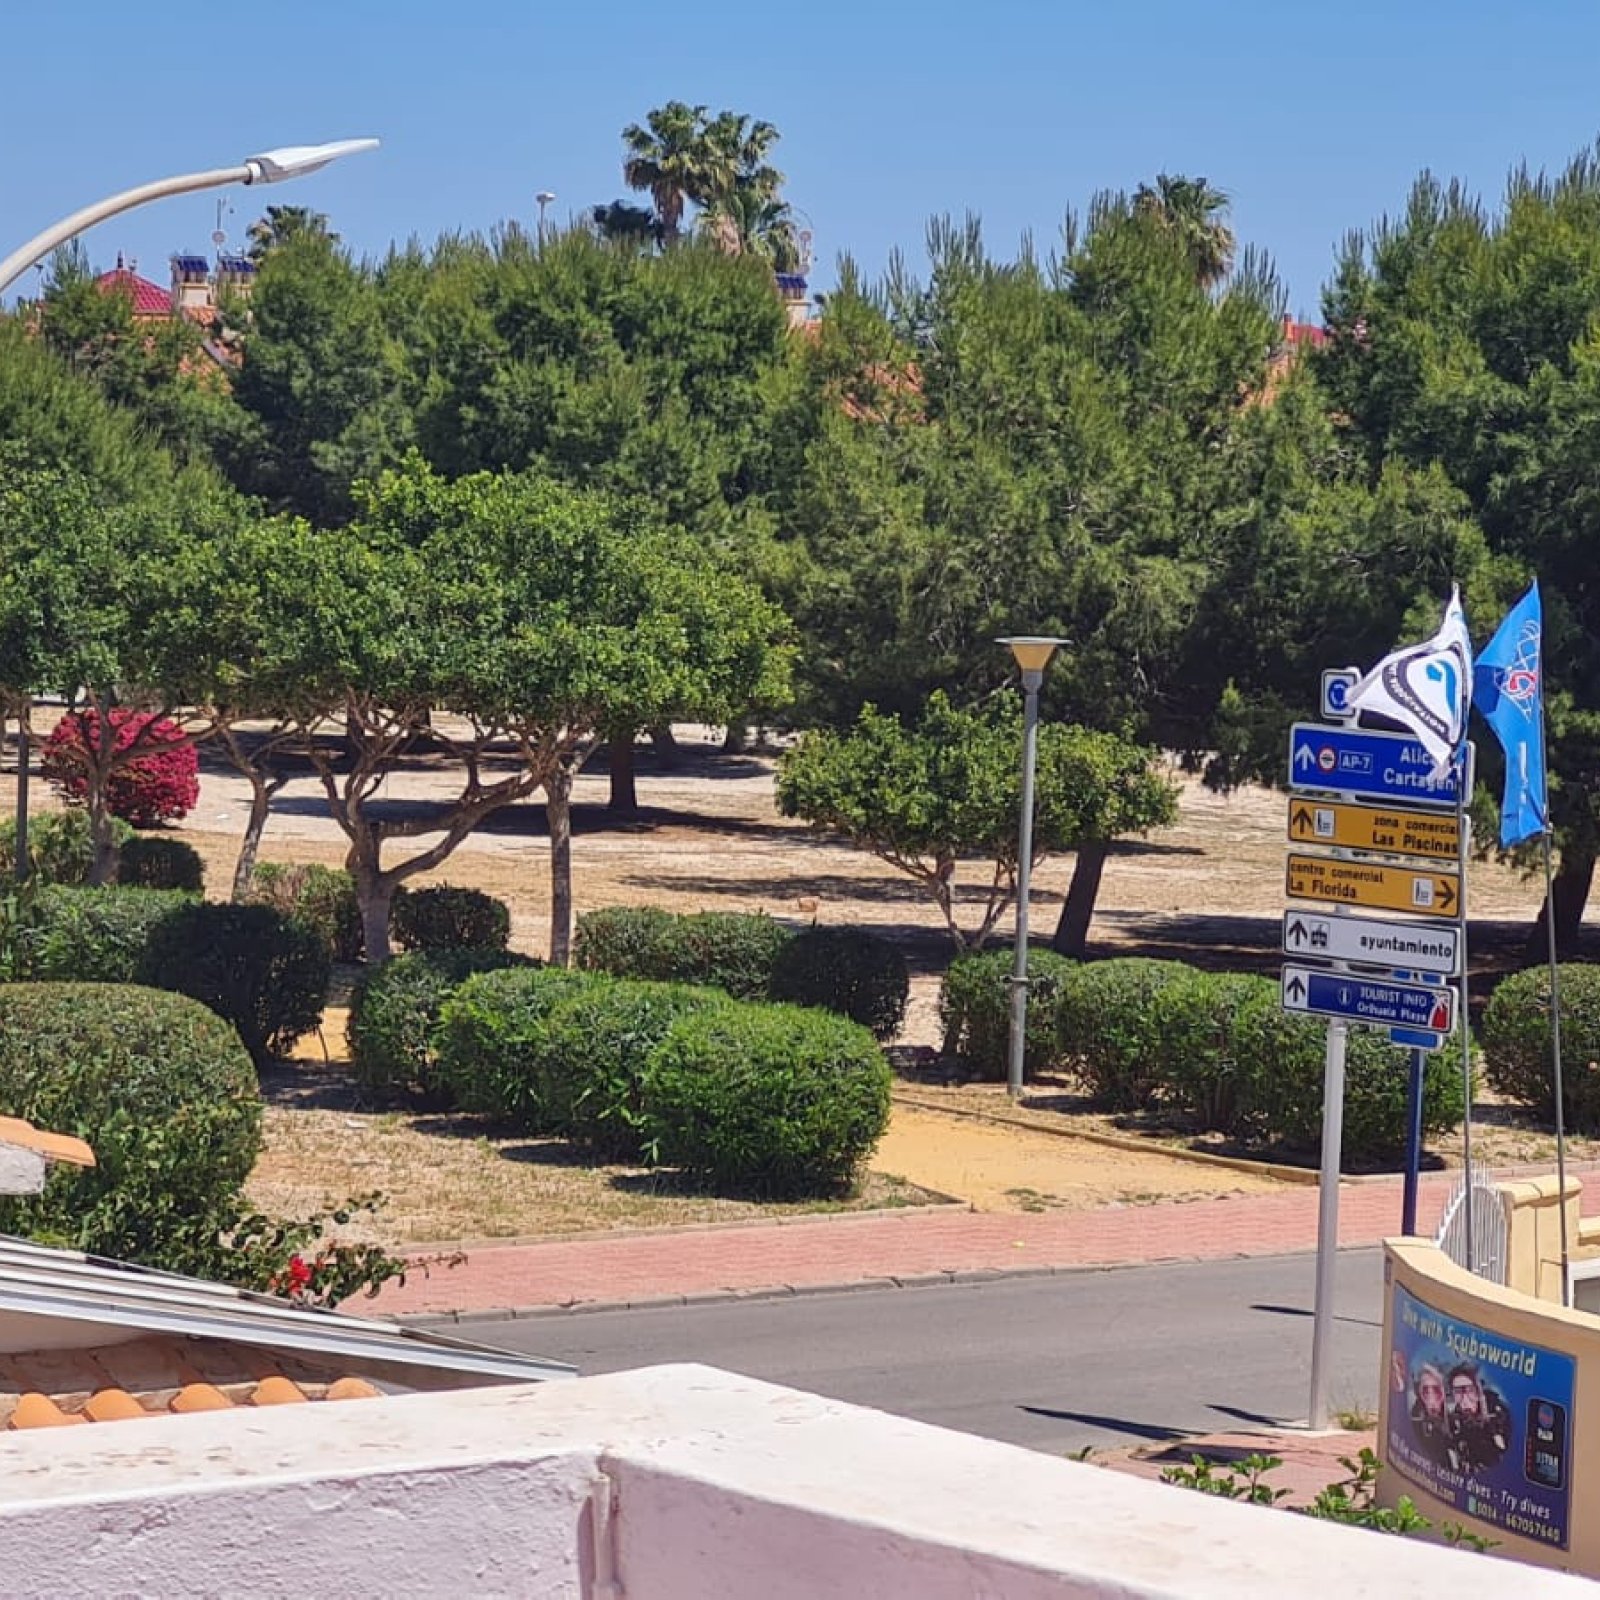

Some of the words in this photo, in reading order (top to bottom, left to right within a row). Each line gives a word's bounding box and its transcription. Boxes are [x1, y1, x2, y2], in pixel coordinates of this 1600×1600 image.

[1341, 754, 1371, 769] AP-7
[1374, 815, 1399, 828] zona
[1372, 829, 1395, 846] Las
[1402, 834, 1458, 854] Piscinas
[1290, 876, 1304, 892] La
[1312, 879, 1358, 899] Florida
[1331, 869, 1384, 884] comercial
[1360, 935, 1452, 957] ayuntamiento
[1360, 986, 1401, 1003] TOURIST
[1402, 992, 1428, 1008] INFO
[1419, 1319, 1444, 1340] with
[1446, 1324, 1537, 1377] Scubaworld
[1466, 1477, 1491, 1500] dives
[1501, 1489, 1518, 1512] Try
[1520, 1497, 1551, 1520] dives
